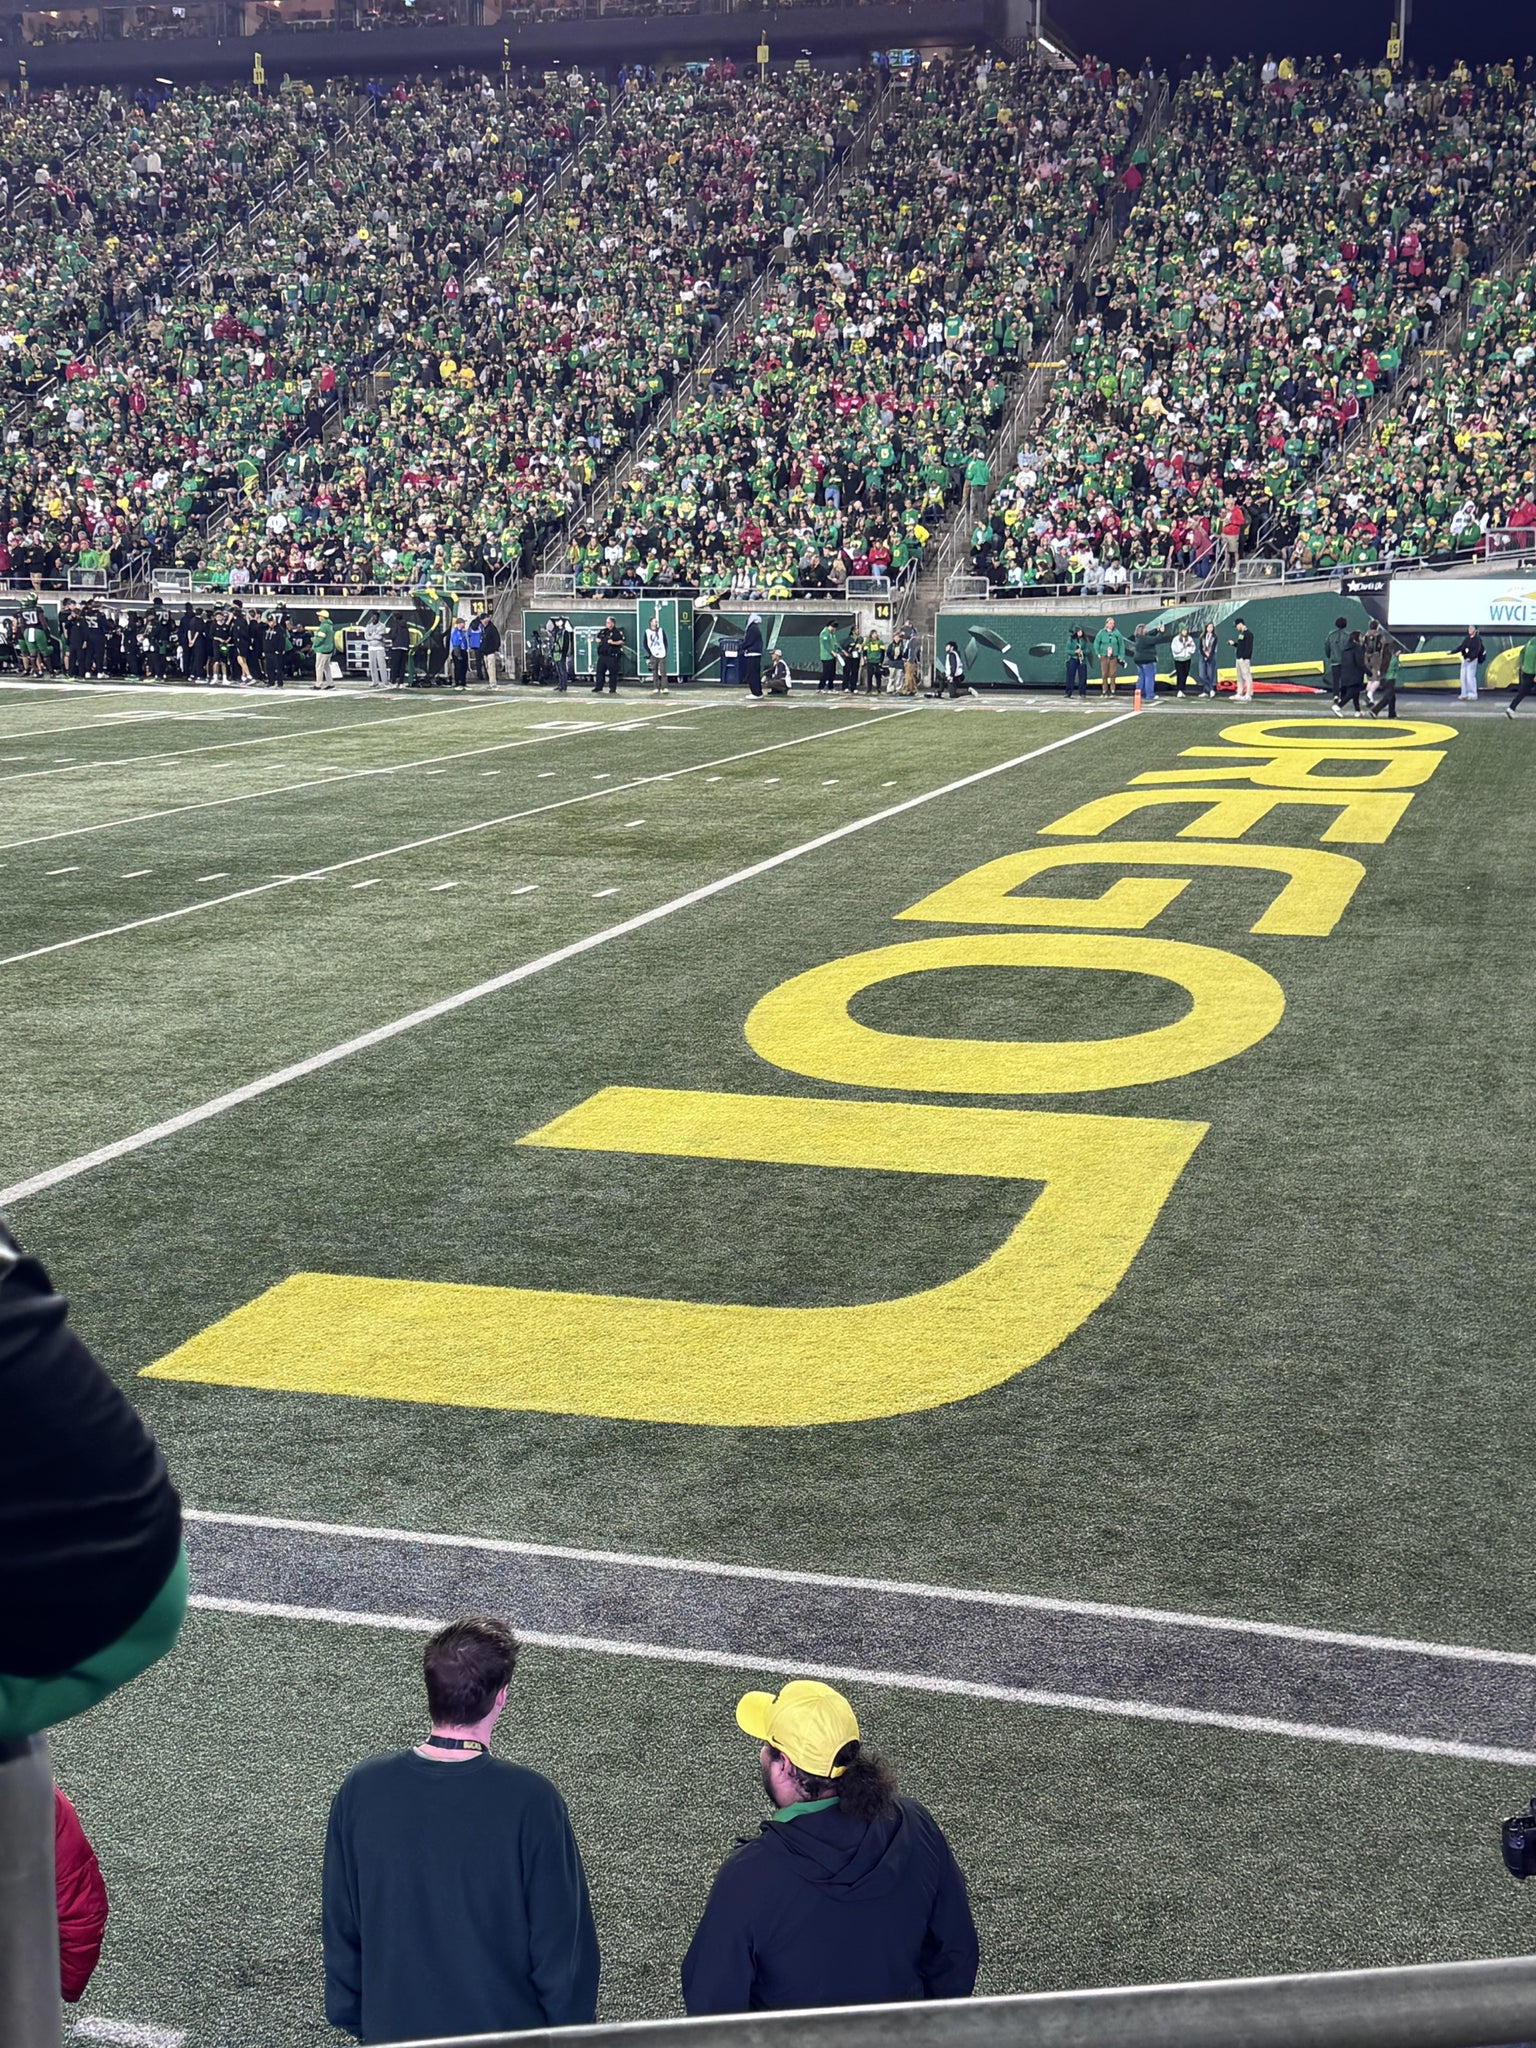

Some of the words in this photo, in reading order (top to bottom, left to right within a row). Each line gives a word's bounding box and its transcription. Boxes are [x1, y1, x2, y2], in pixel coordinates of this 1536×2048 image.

[22, 611, 38, 625] 50
[876, 605, 889, 618] 14
[1489, 605, 1527, 621] WVCI
[138, 717, 1458, 1428] OREGON
